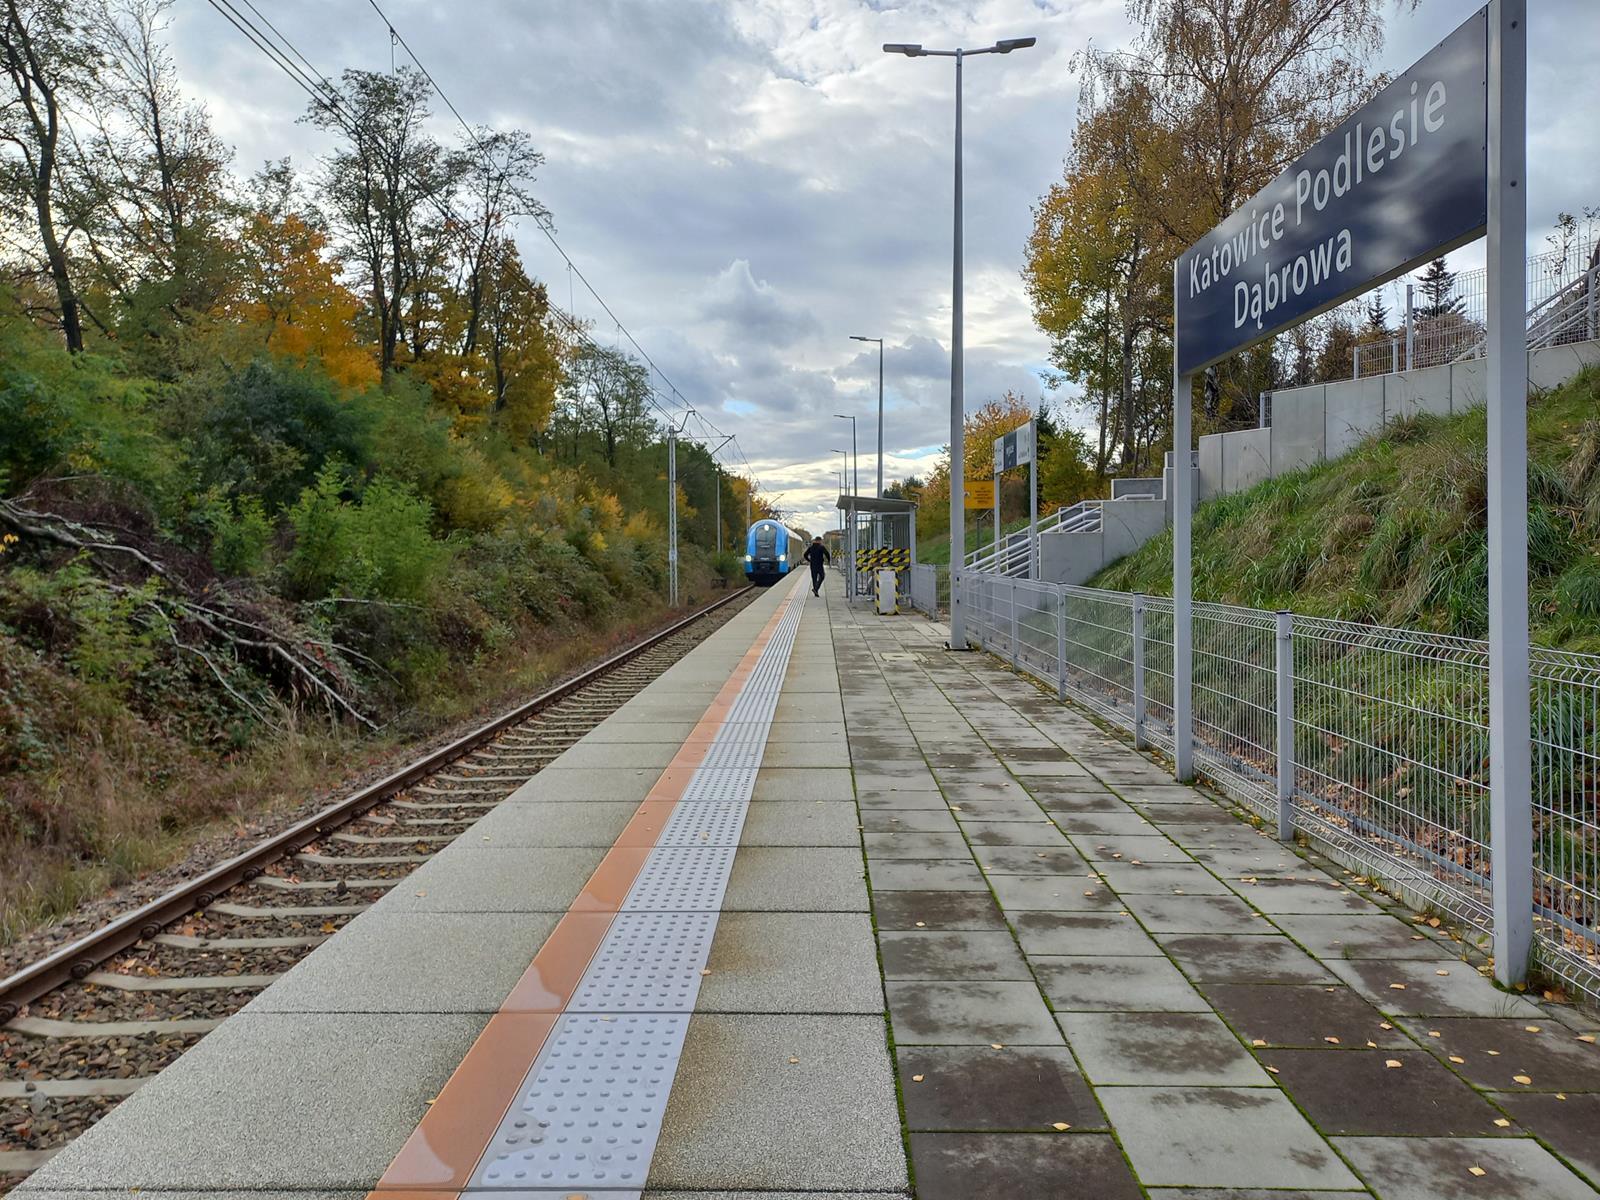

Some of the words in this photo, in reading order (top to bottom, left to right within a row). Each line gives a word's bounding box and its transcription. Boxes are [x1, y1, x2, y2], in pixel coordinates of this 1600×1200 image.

[1189, 202, 1285, 298] Katowice
[1295, 80, 1447, 225] Podlesie
[1233, 228, 1353, 330] Dąbrowa
